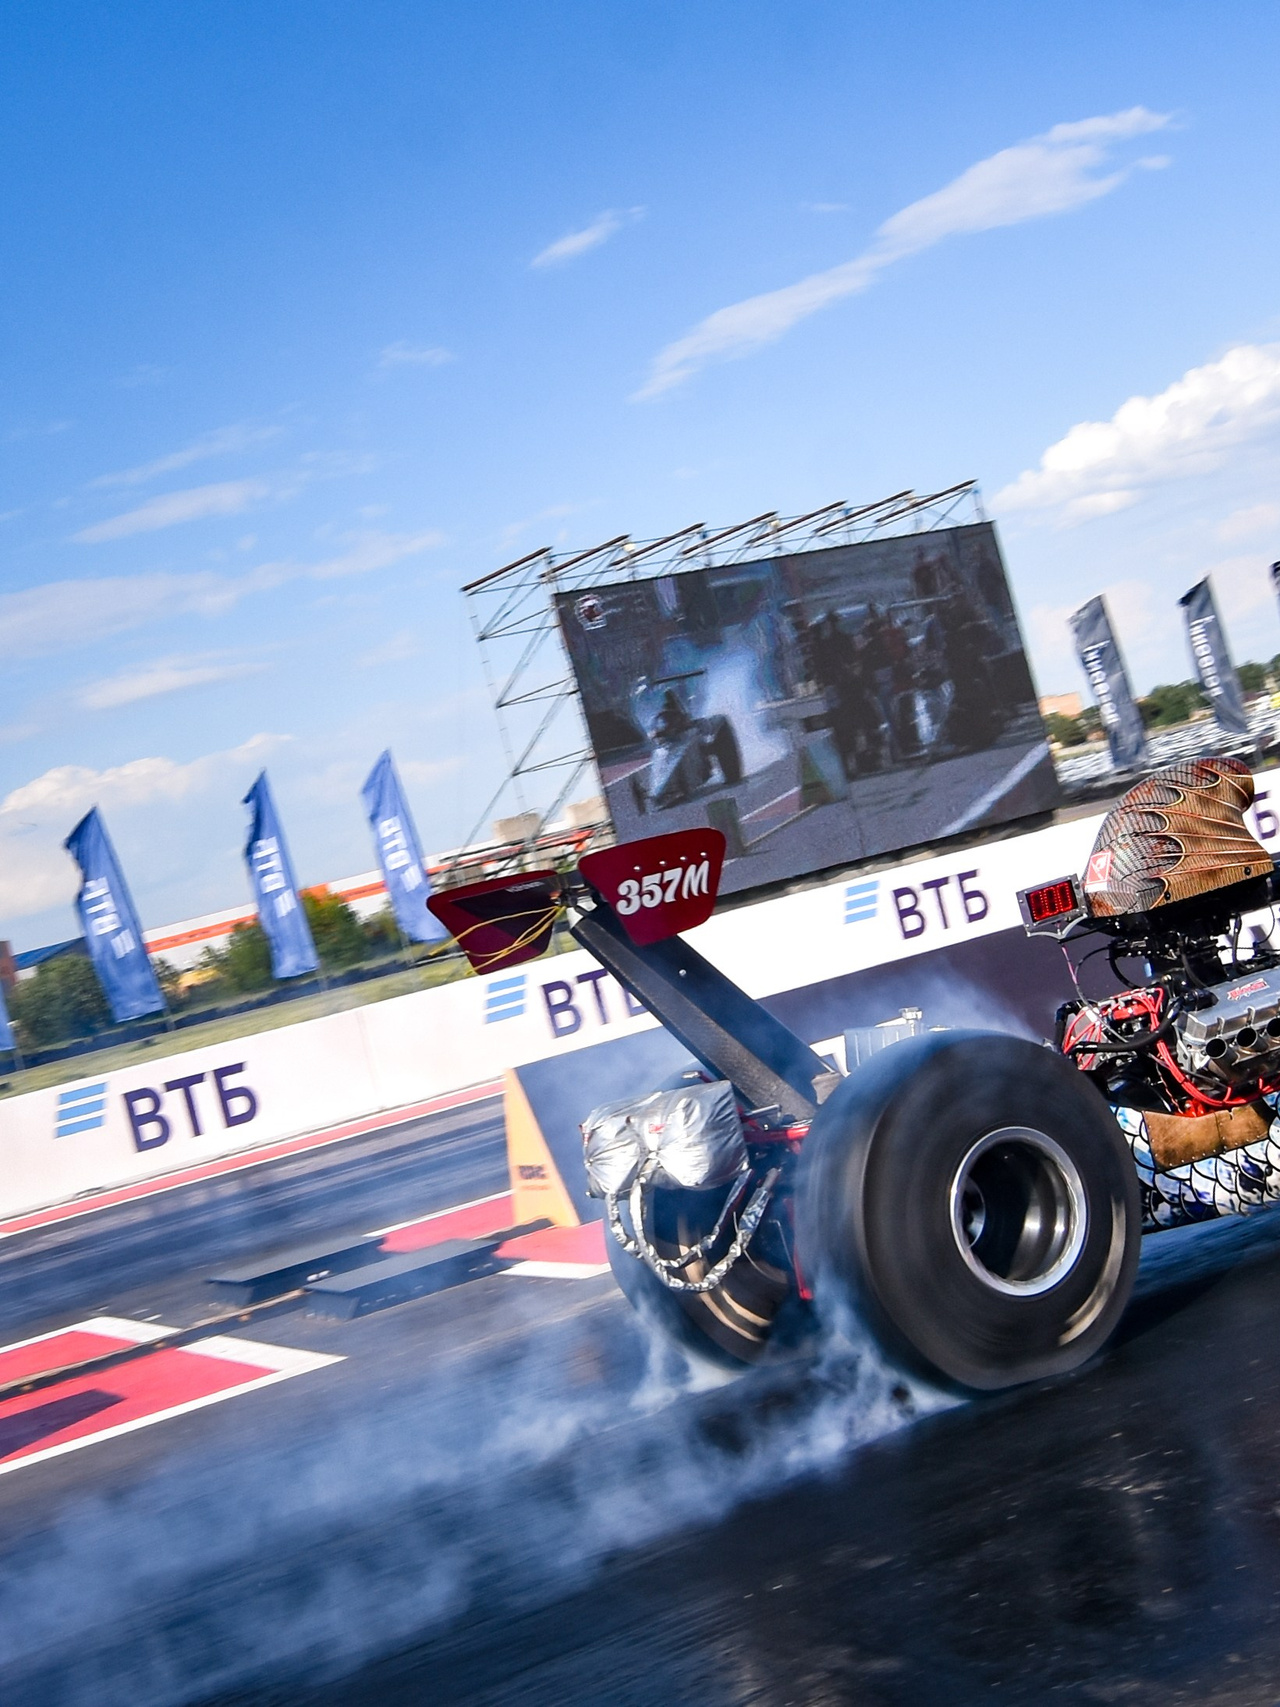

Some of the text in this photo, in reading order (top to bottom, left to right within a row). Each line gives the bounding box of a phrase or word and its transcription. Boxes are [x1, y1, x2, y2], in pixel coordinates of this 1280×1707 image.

[616, 860, 709, 915] 357M
[891, 869, 991, 940] ВТБ
[122, 1061, 259, 1153] ВТБ
